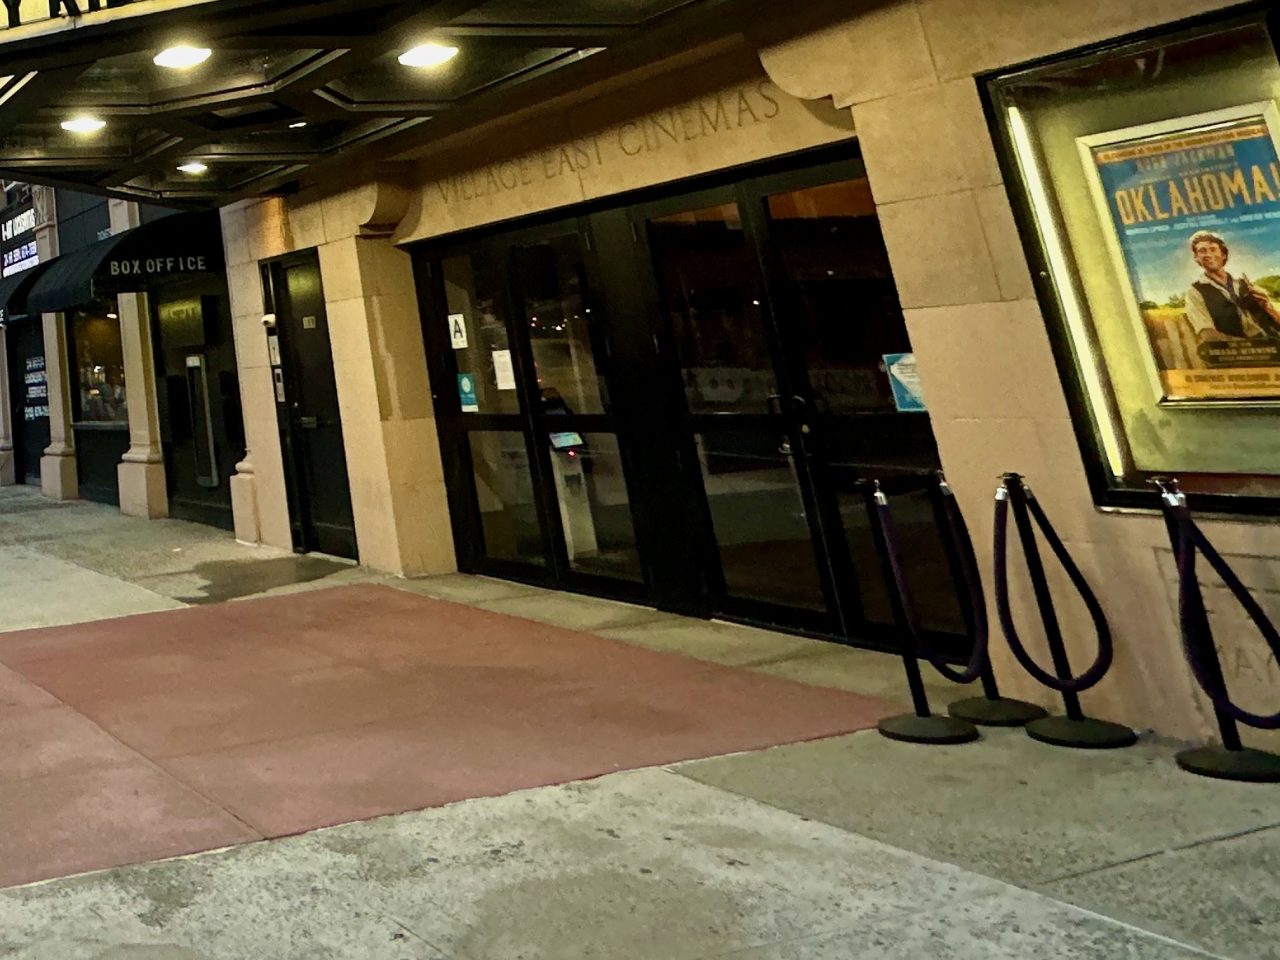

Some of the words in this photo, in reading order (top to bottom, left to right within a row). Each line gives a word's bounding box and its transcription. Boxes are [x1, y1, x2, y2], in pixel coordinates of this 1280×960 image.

[434, 157, 532, 204] VILLAGE
[542, 137, 604, 180] EAST
[619, 78, 781, 157] CINEMAS
[110, 259, 142, 276] BOX
[146, 256, 207, 273] OFFICE
[453, 319, 464, 339] A
